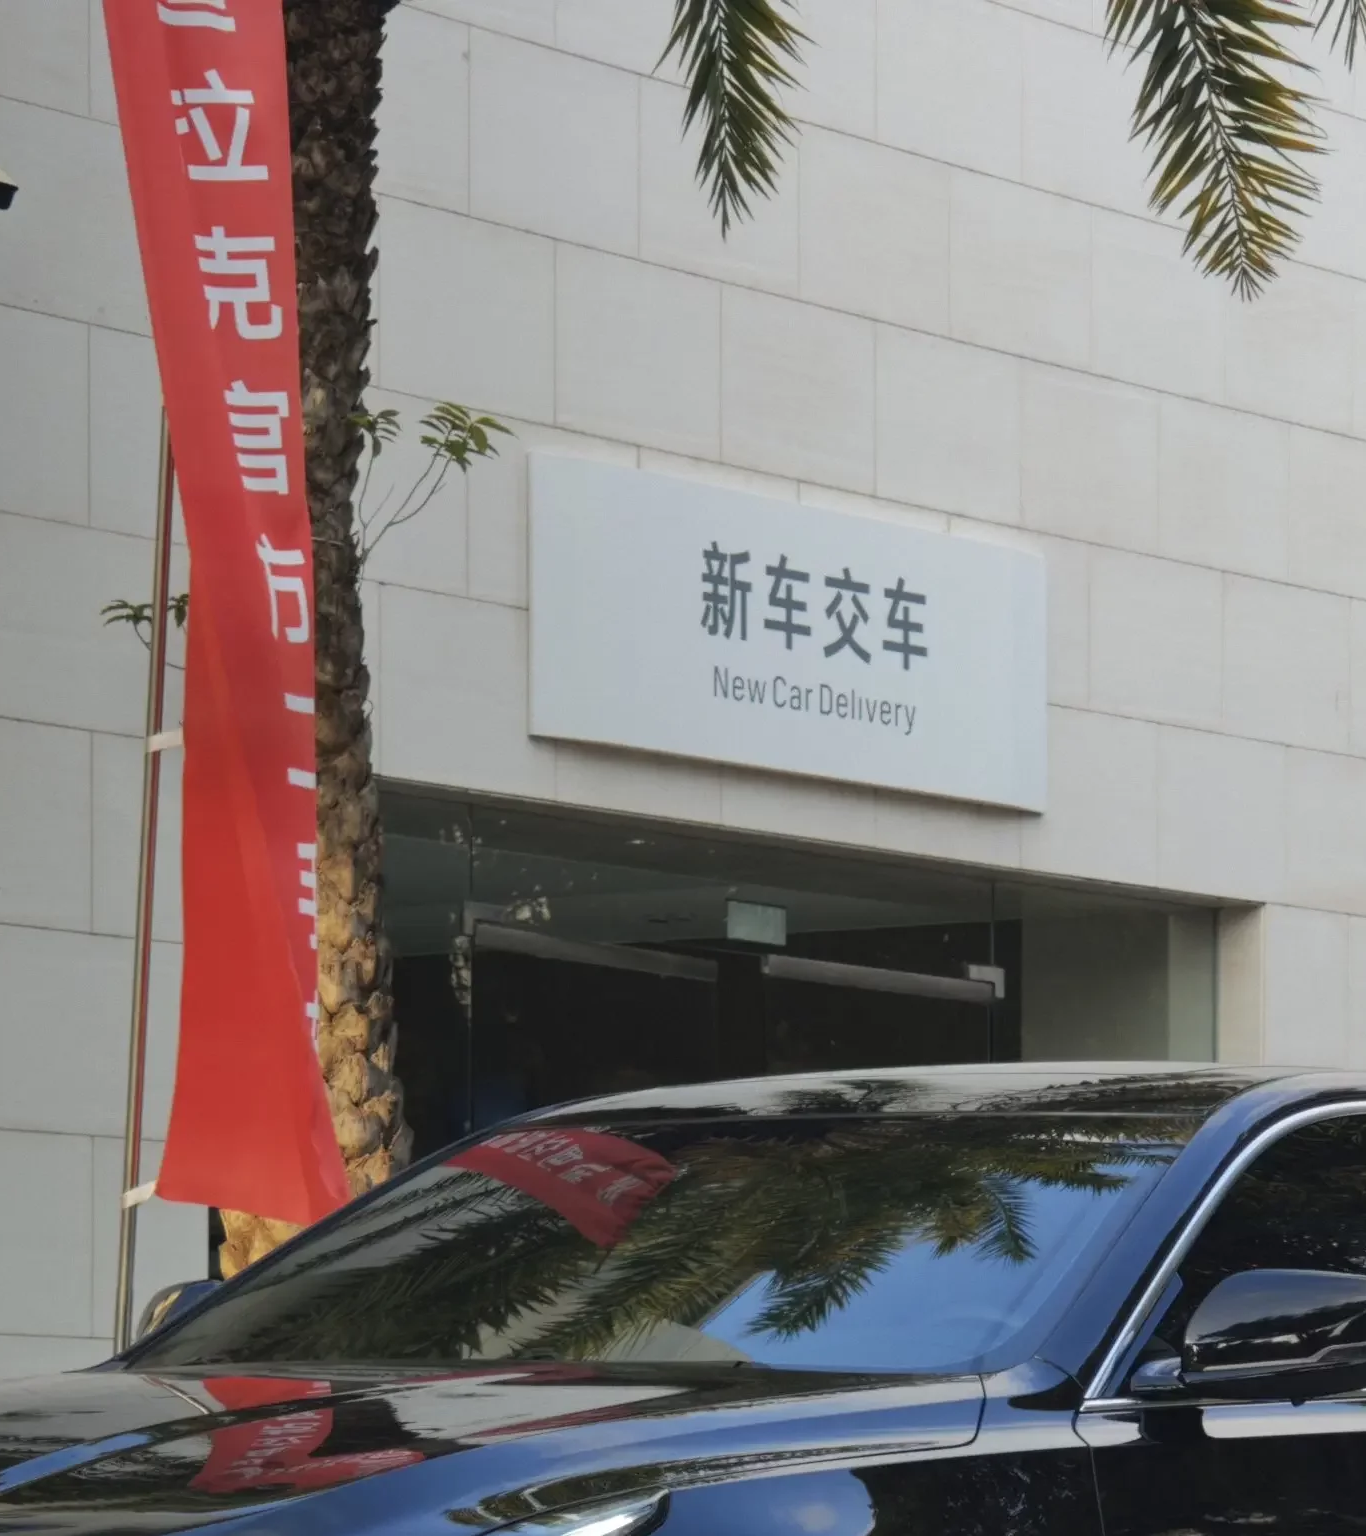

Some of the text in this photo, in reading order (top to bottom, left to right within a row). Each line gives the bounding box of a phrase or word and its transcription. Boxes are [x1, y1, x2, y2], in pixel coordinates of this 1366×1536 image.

[700, 541, 928, 671] 新车交车
[713, 665, 917, 736] New Car Delivery
